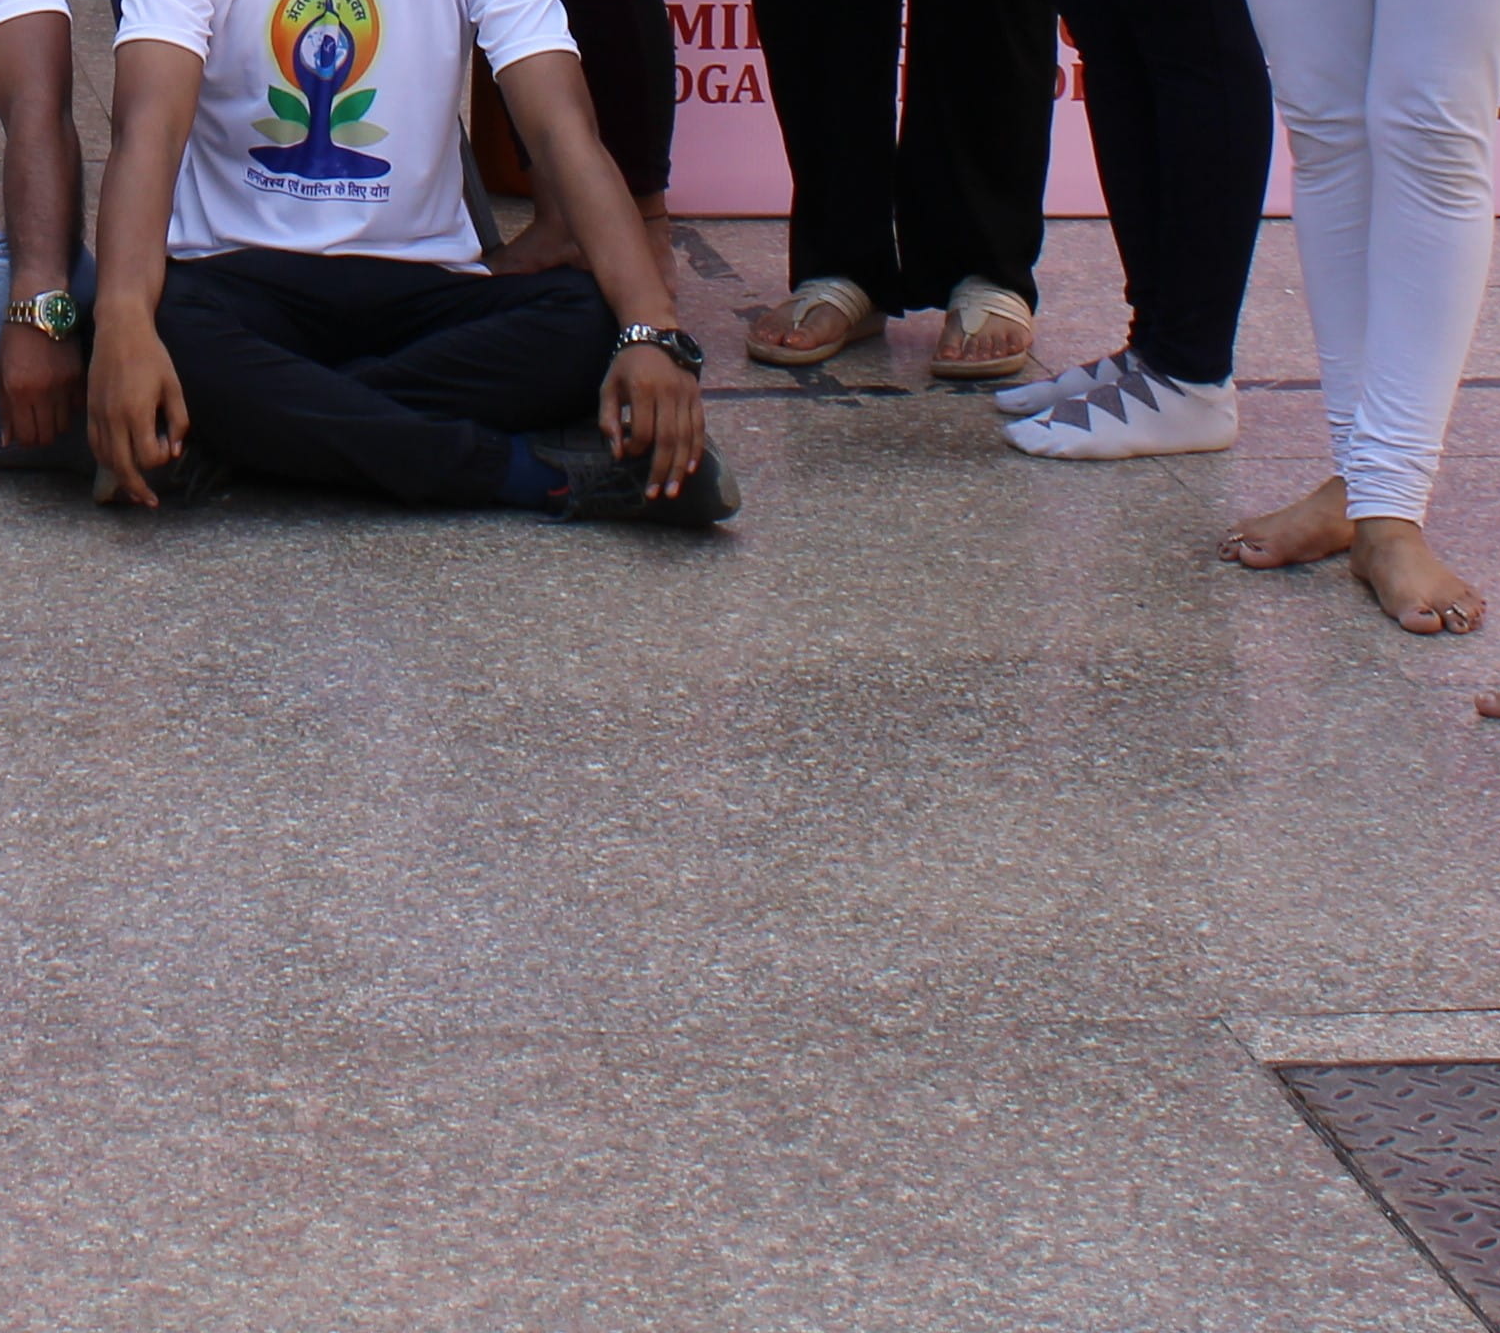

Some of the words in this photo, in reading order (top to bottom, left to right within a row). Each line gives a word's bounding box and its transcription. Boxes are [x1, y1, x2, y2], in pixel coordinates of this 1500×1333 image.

[301, 181, 331, 197] शान्ति
[334, 182, 345, 196] के
[348, 183, 367, 200] लिए
[370, 183, 390, 199] योग
